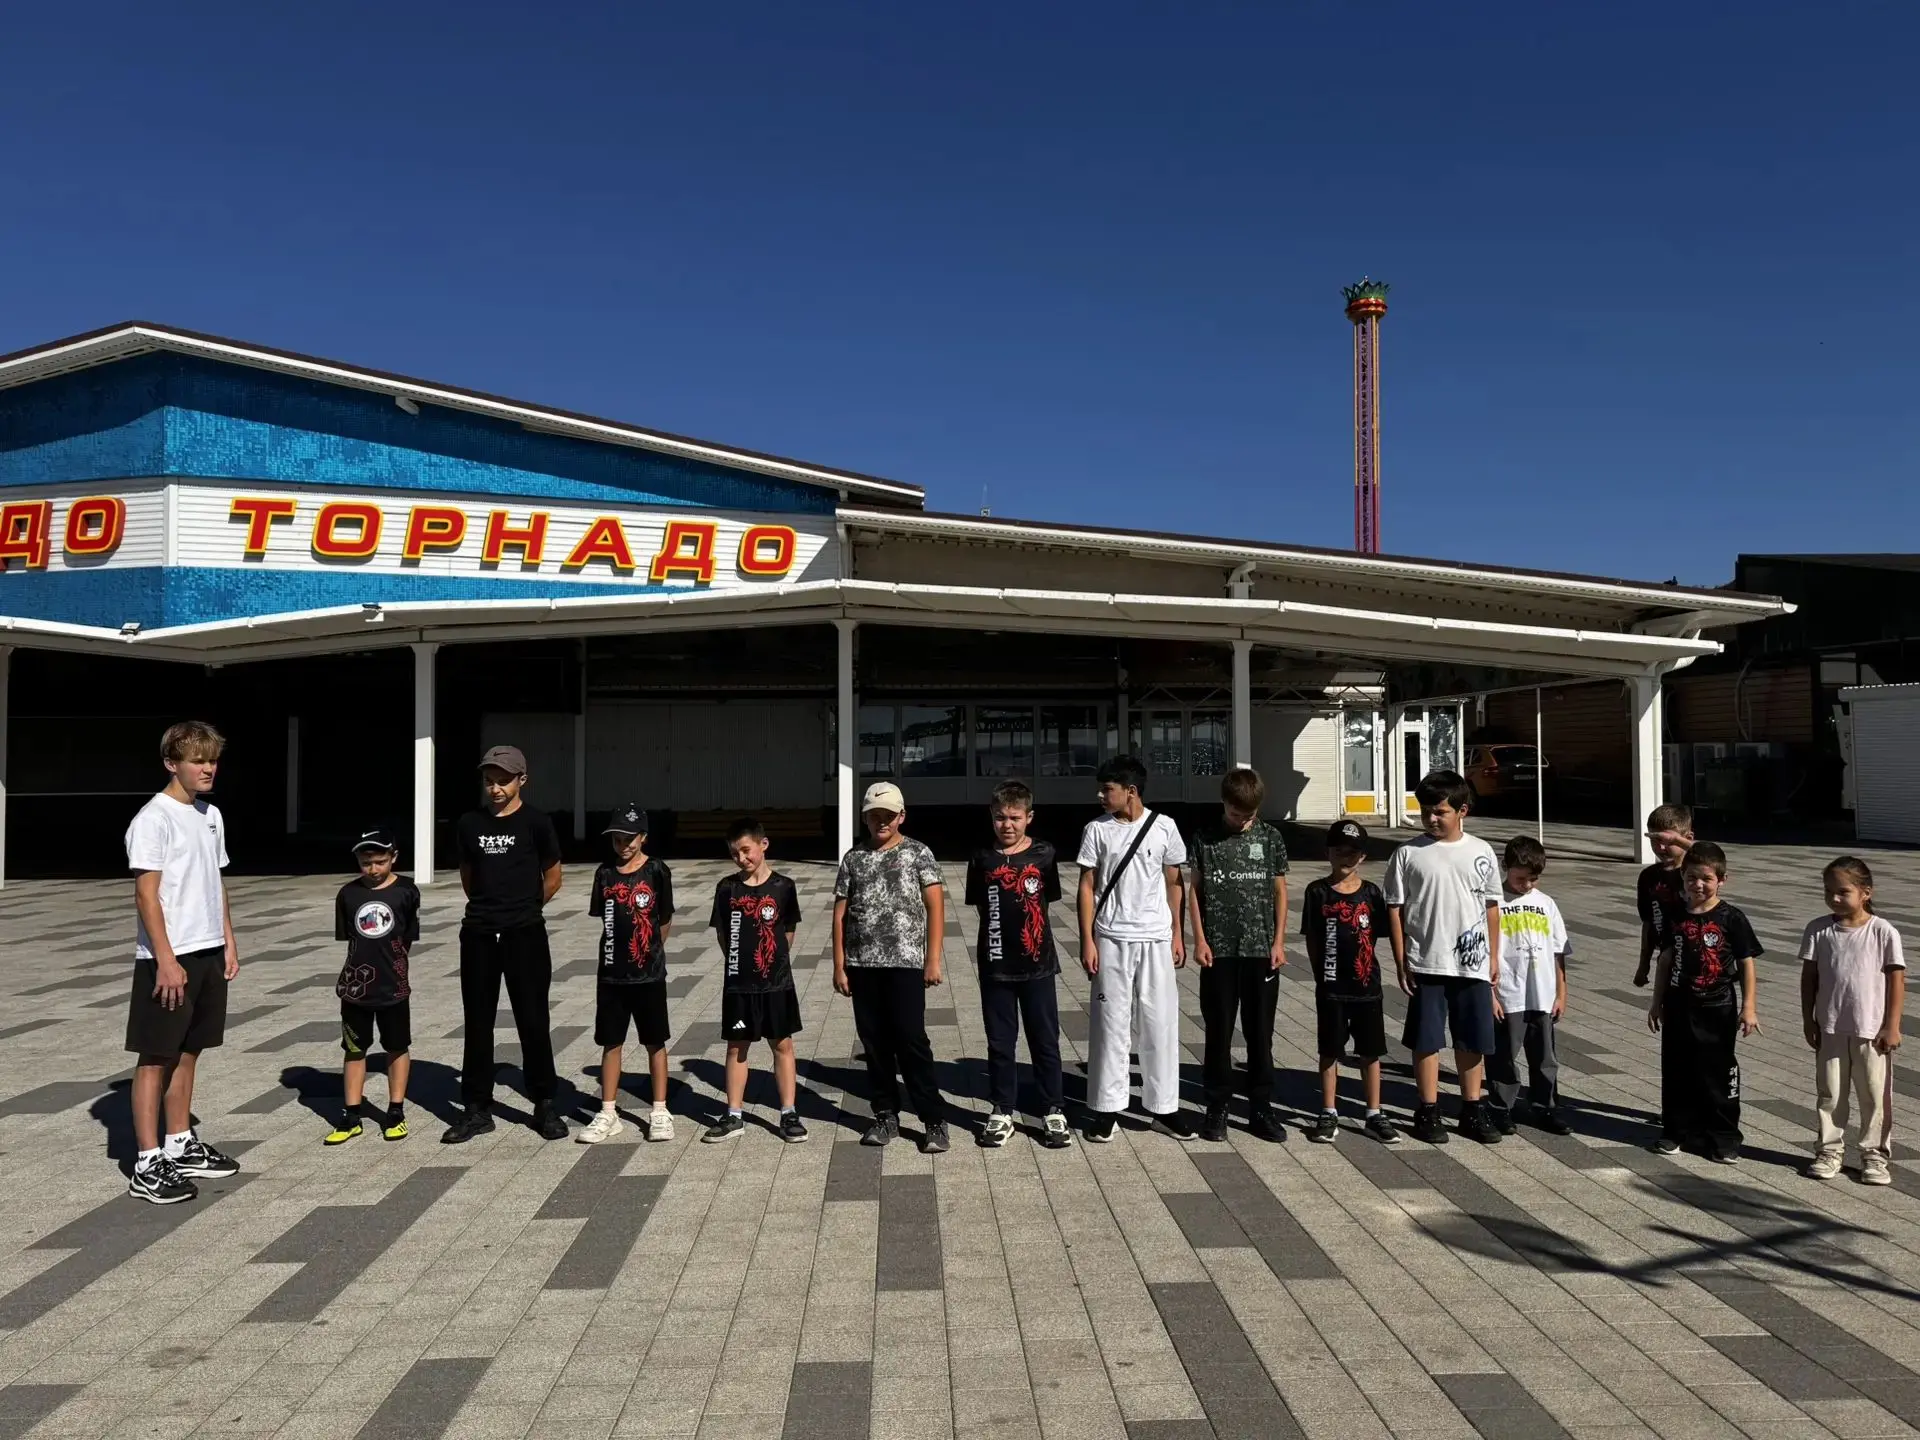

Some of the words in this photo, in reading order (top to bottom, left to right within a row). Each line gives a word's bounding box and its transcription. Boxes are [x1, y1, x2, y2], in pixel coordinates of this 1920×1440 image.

[0, 496, 122, 568] ДО
[230, 498, 798, 582] ТОРНАДО
[604, 898, 615, 967] TAEKWONDO
[728, 910, 742, 977] TAEKWONDO
[987, 884, 1003, 962] TAEKWONDO
[1500, 905, 1521, 915] THE
[1522, 905, 1546, 916] REAL
[1323, 917, 1337, 982] TAEKWONDO
